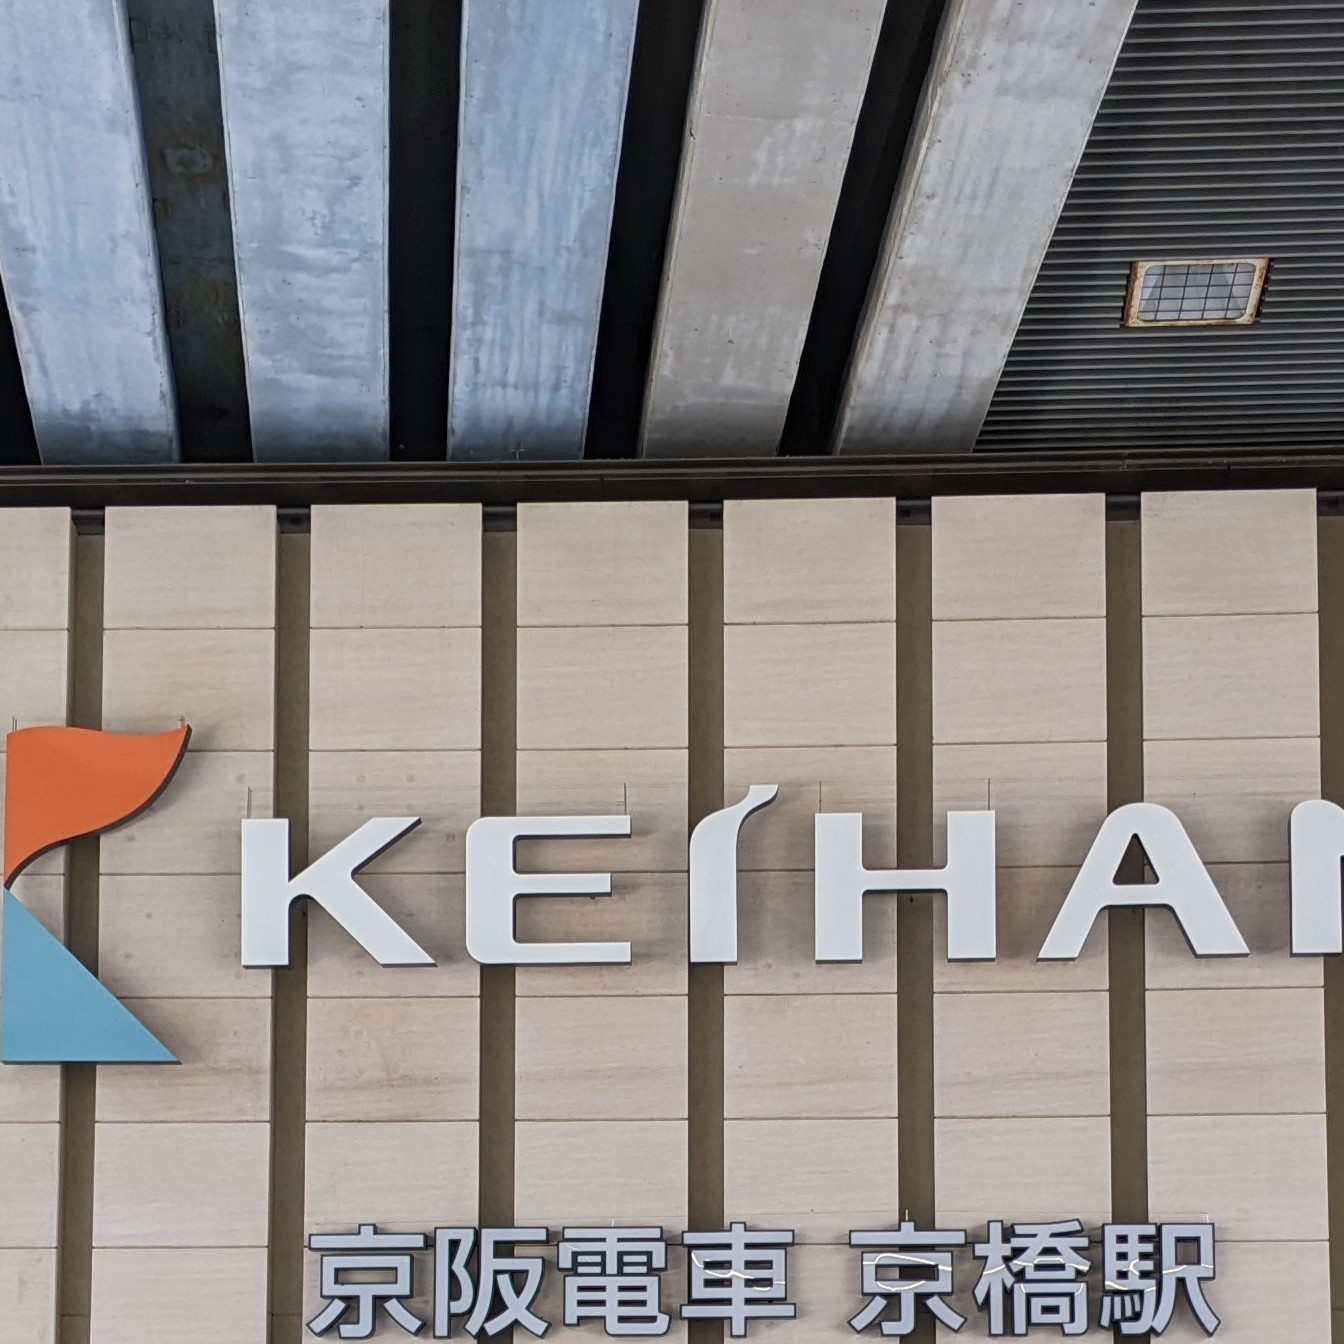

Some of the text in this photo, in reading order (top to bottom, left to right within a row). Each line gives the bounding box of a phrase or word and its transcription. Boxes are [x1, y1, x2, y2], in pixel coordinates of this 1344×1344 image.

[306, 1219, 1222, 1340] 京阪電車 京橋駅
